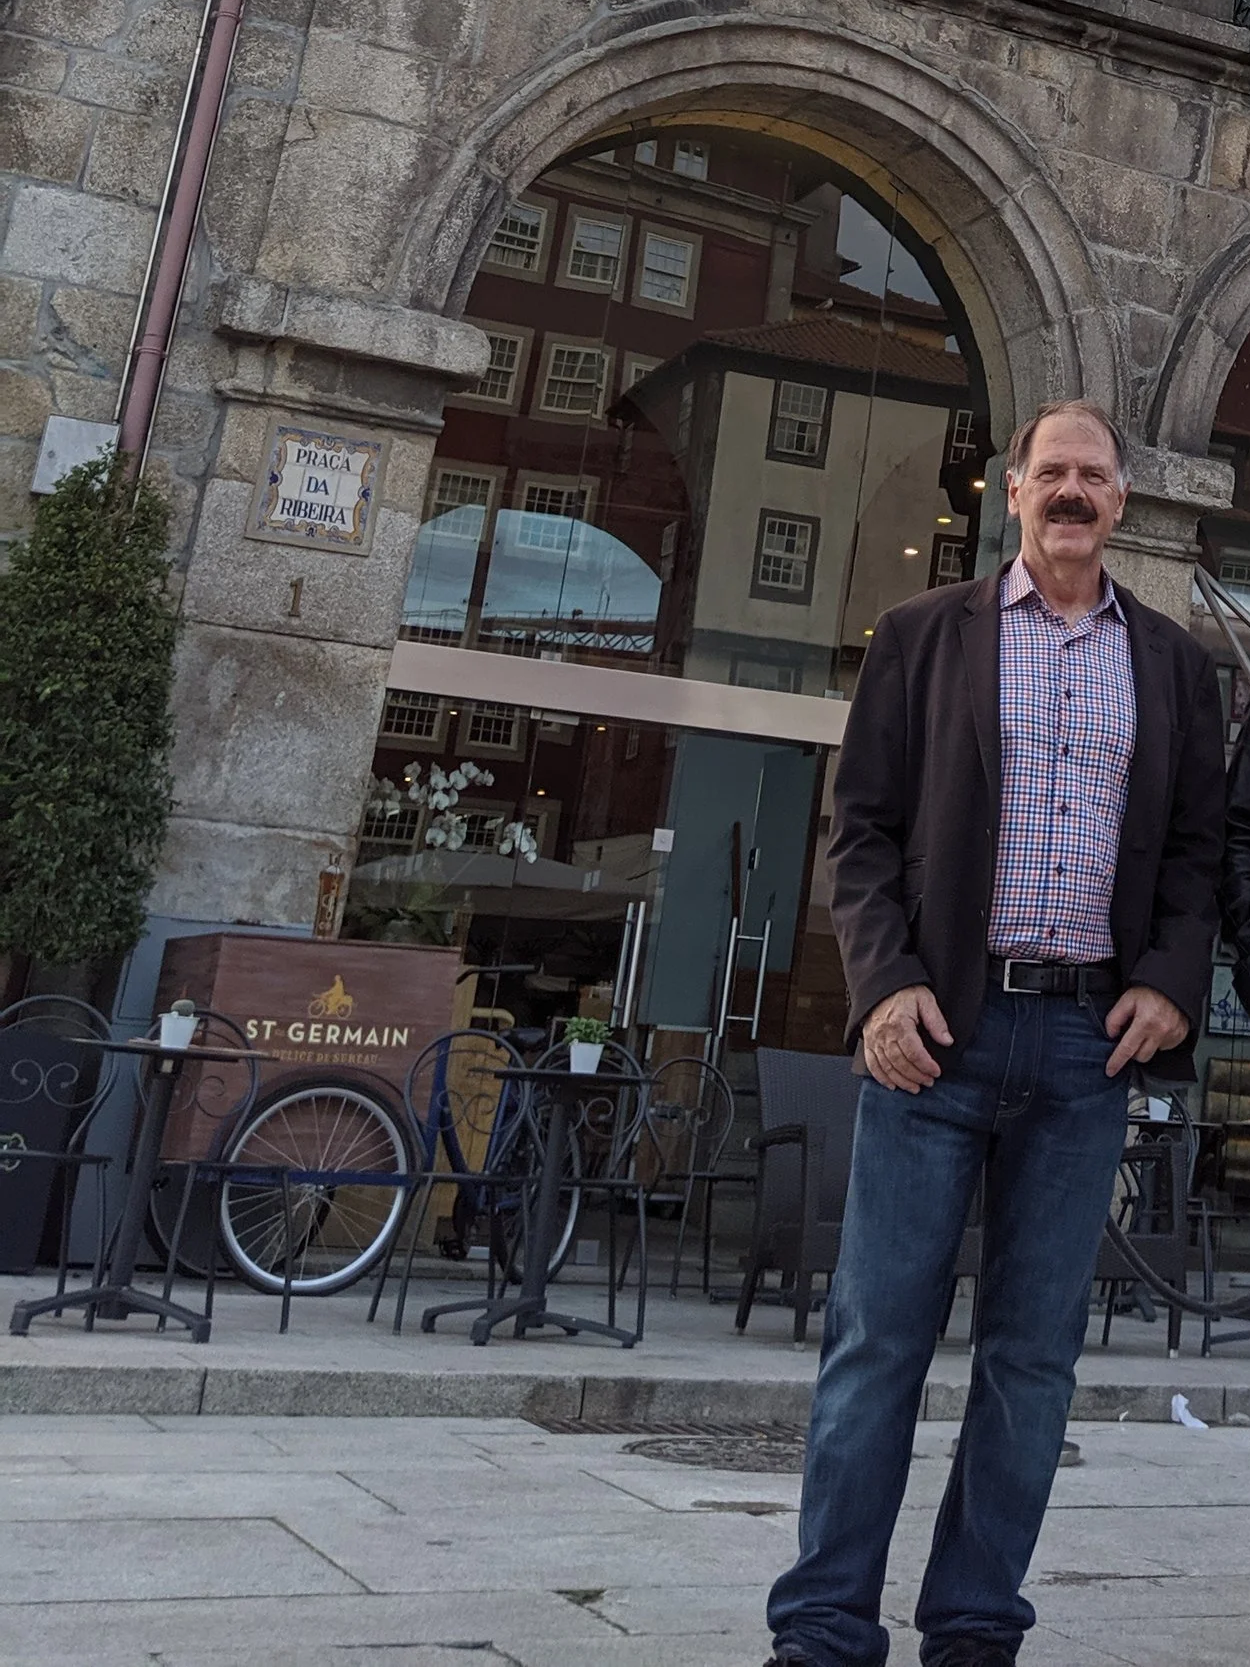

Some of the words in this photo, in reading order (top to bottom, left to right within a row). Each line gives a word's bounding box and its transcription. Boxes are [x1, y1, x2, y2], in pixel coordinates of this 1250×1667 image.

[296, 448, 351, 472] PRAÇA
[305, 476, 330, 496] DA
[279, 498, 347, 525] RIBEIRA
[288, 577, 303, 617] 1
[287, 1022, 408, 1047] GERMAIN
